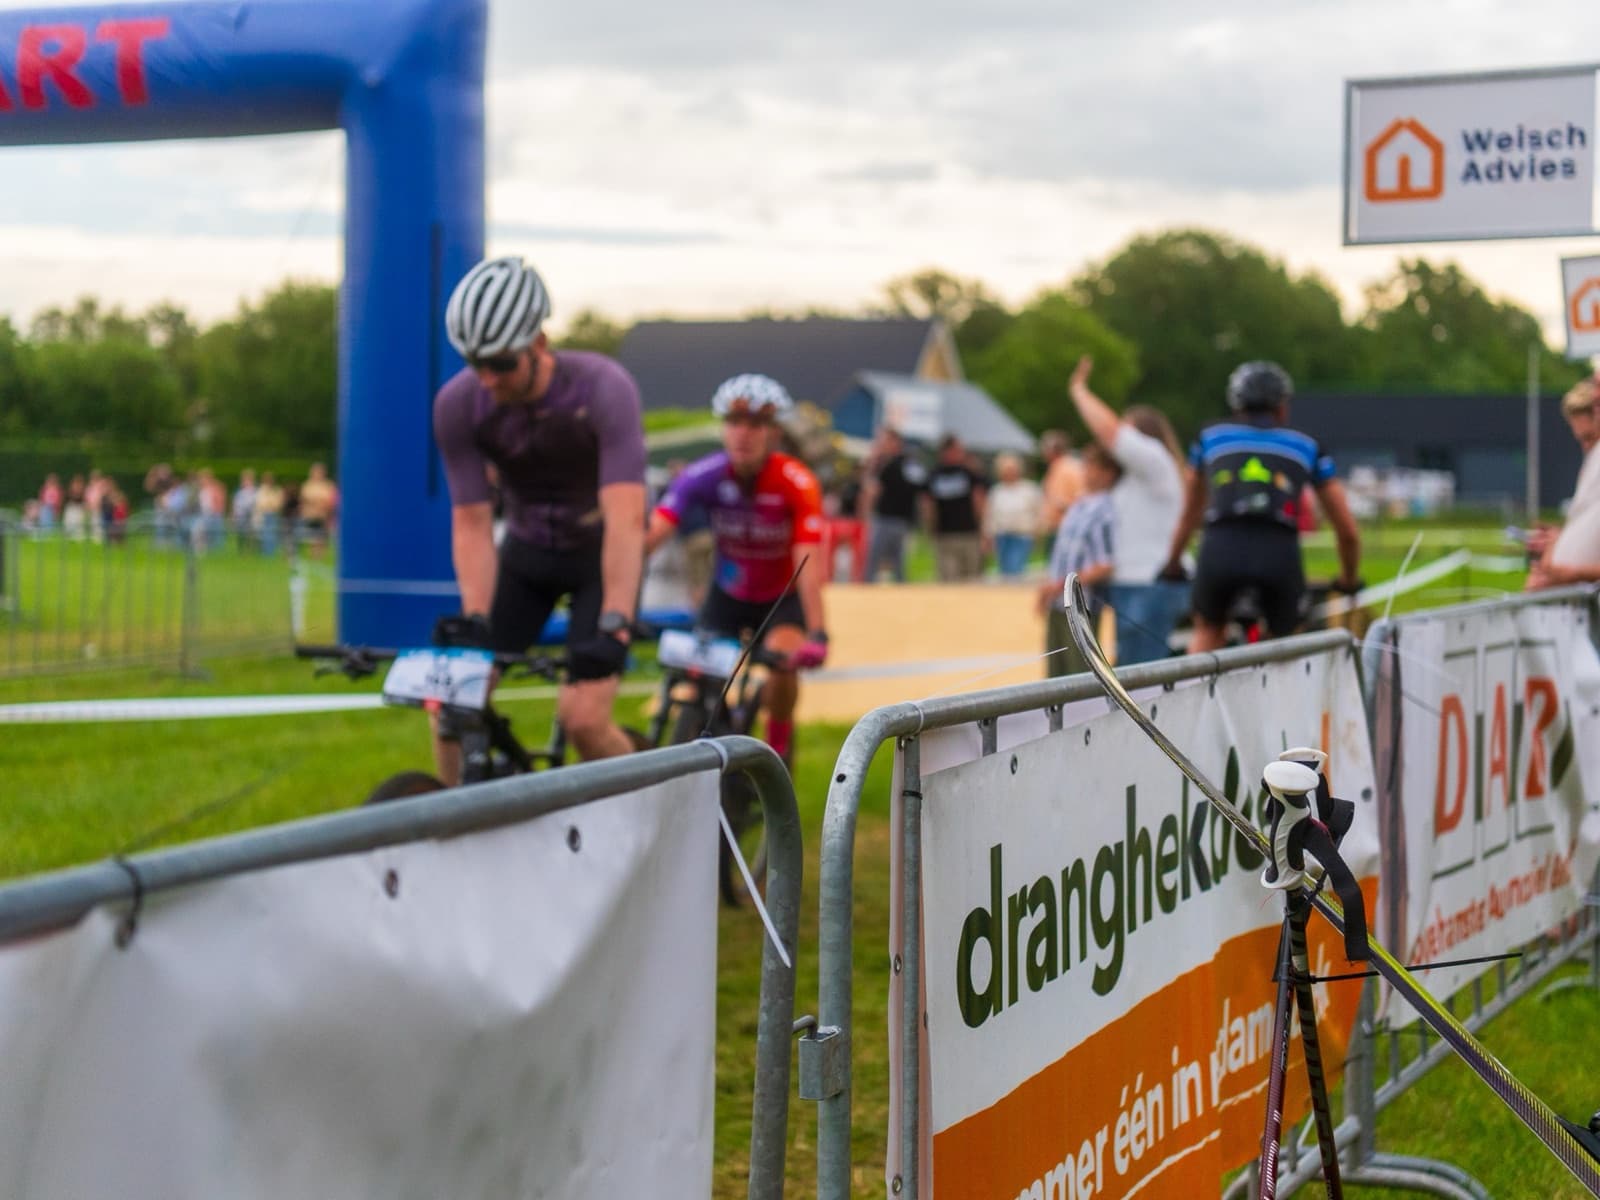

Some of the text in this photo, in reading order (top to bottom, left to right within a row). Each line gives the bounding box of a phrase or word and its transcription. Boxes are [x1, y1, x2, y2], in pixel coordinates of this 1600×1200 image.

[1461, 122, 1587, 153] Weisch
[1461, 155, 1576, 183] Advies
[1114, 1072, 1164, 1175] één
[1172, 1045, 1203, 1130] in
